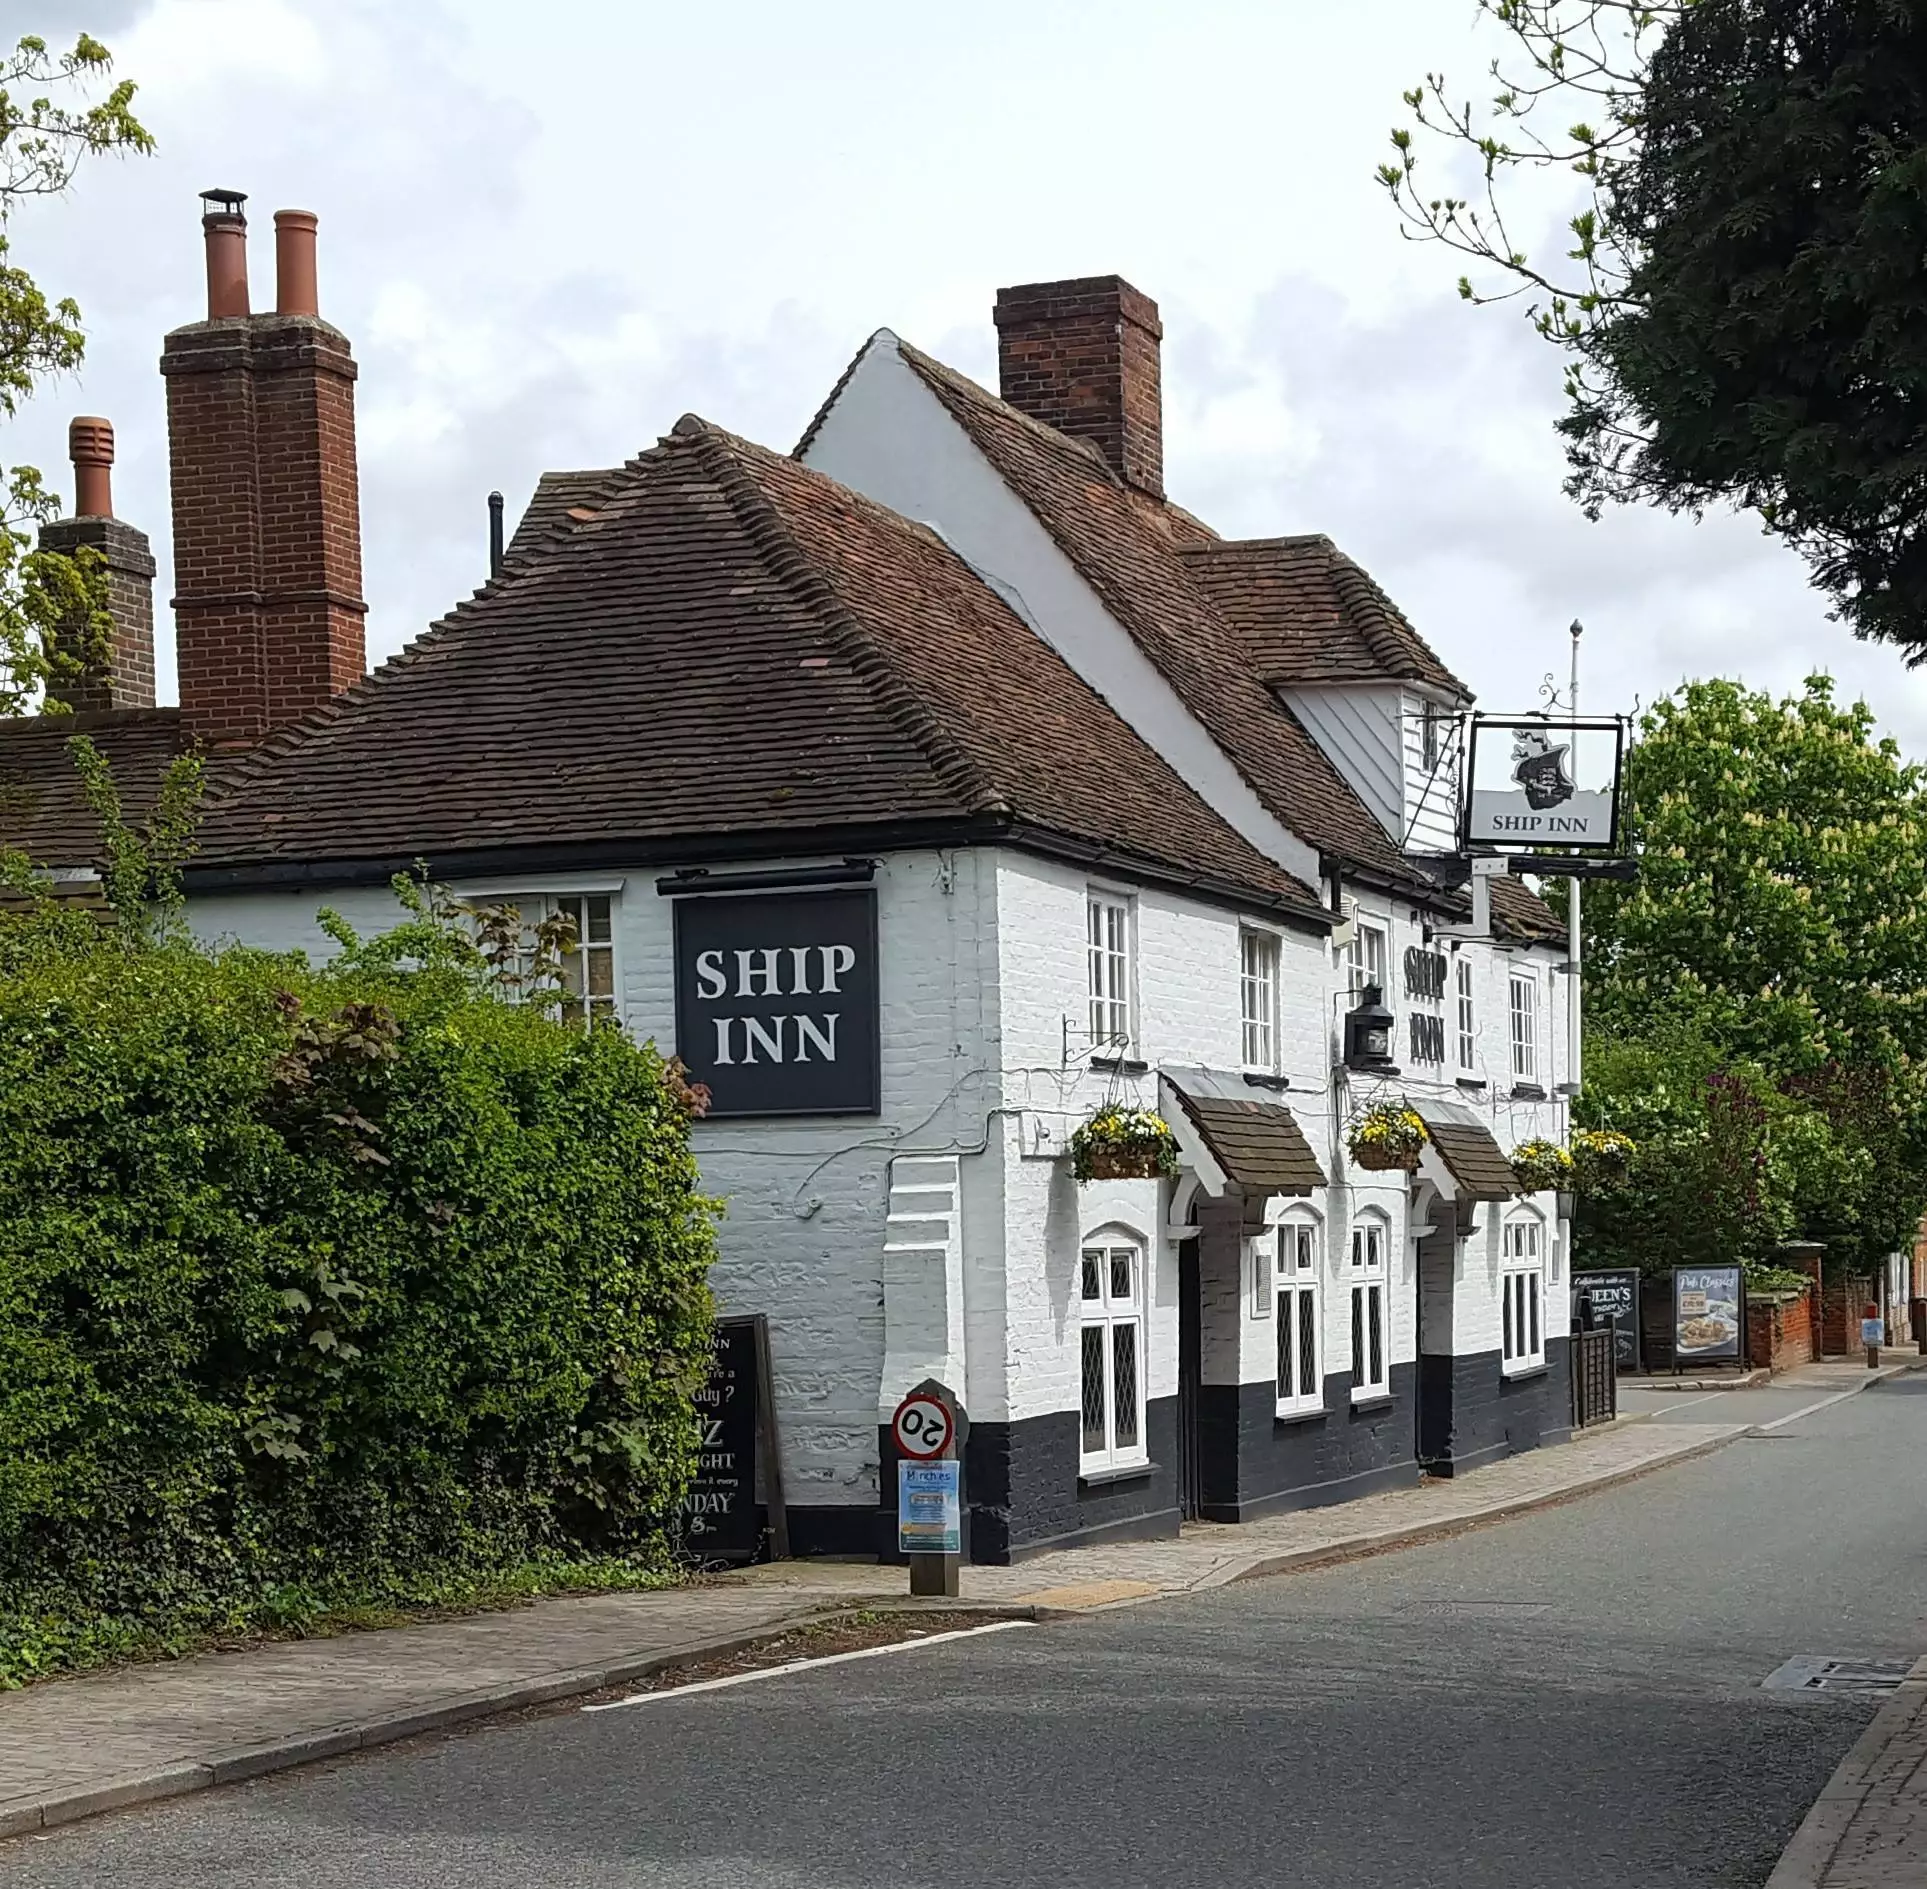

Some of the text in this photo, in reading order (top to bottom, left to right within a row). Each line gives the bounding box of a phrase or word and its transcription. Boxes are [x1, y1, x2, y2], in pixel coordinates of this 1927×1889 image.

[1492, 815, 1589, 833] SHIP INN
[696, 944, 857, 1000] SHIP
[1404, 945, 1447, 1000] SHIP
[712, 1012, 841, 1066] INN
[1409, 1011, 1445, 1064] INN
[901, 1408, 945, 1447] 20
[700, 1452, 736, 1470] GHT
[680, 1492, 736, 1514] NDAY
